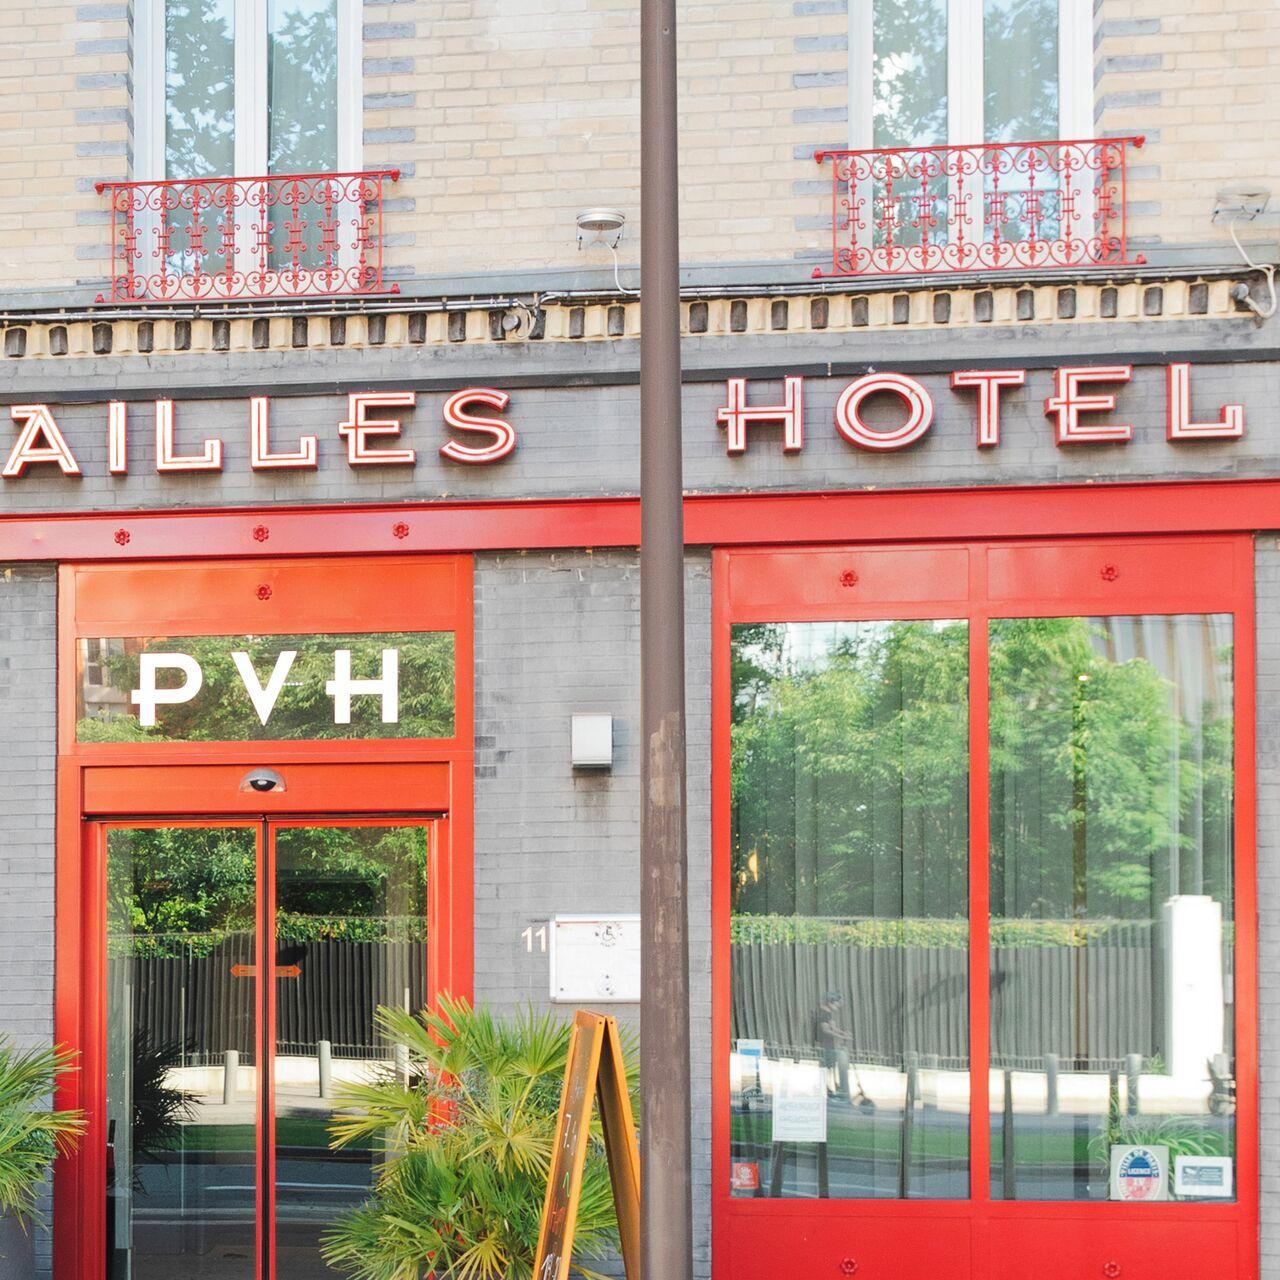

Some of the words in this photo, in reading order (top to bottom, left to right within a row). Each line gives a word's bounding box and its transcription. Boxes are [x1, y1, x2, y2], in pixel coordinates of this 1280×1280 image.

[717, 361, 1245, 455] HOTEL
[131, 649, 398, 726] PVH
[521, 926, 547, 953] 11
